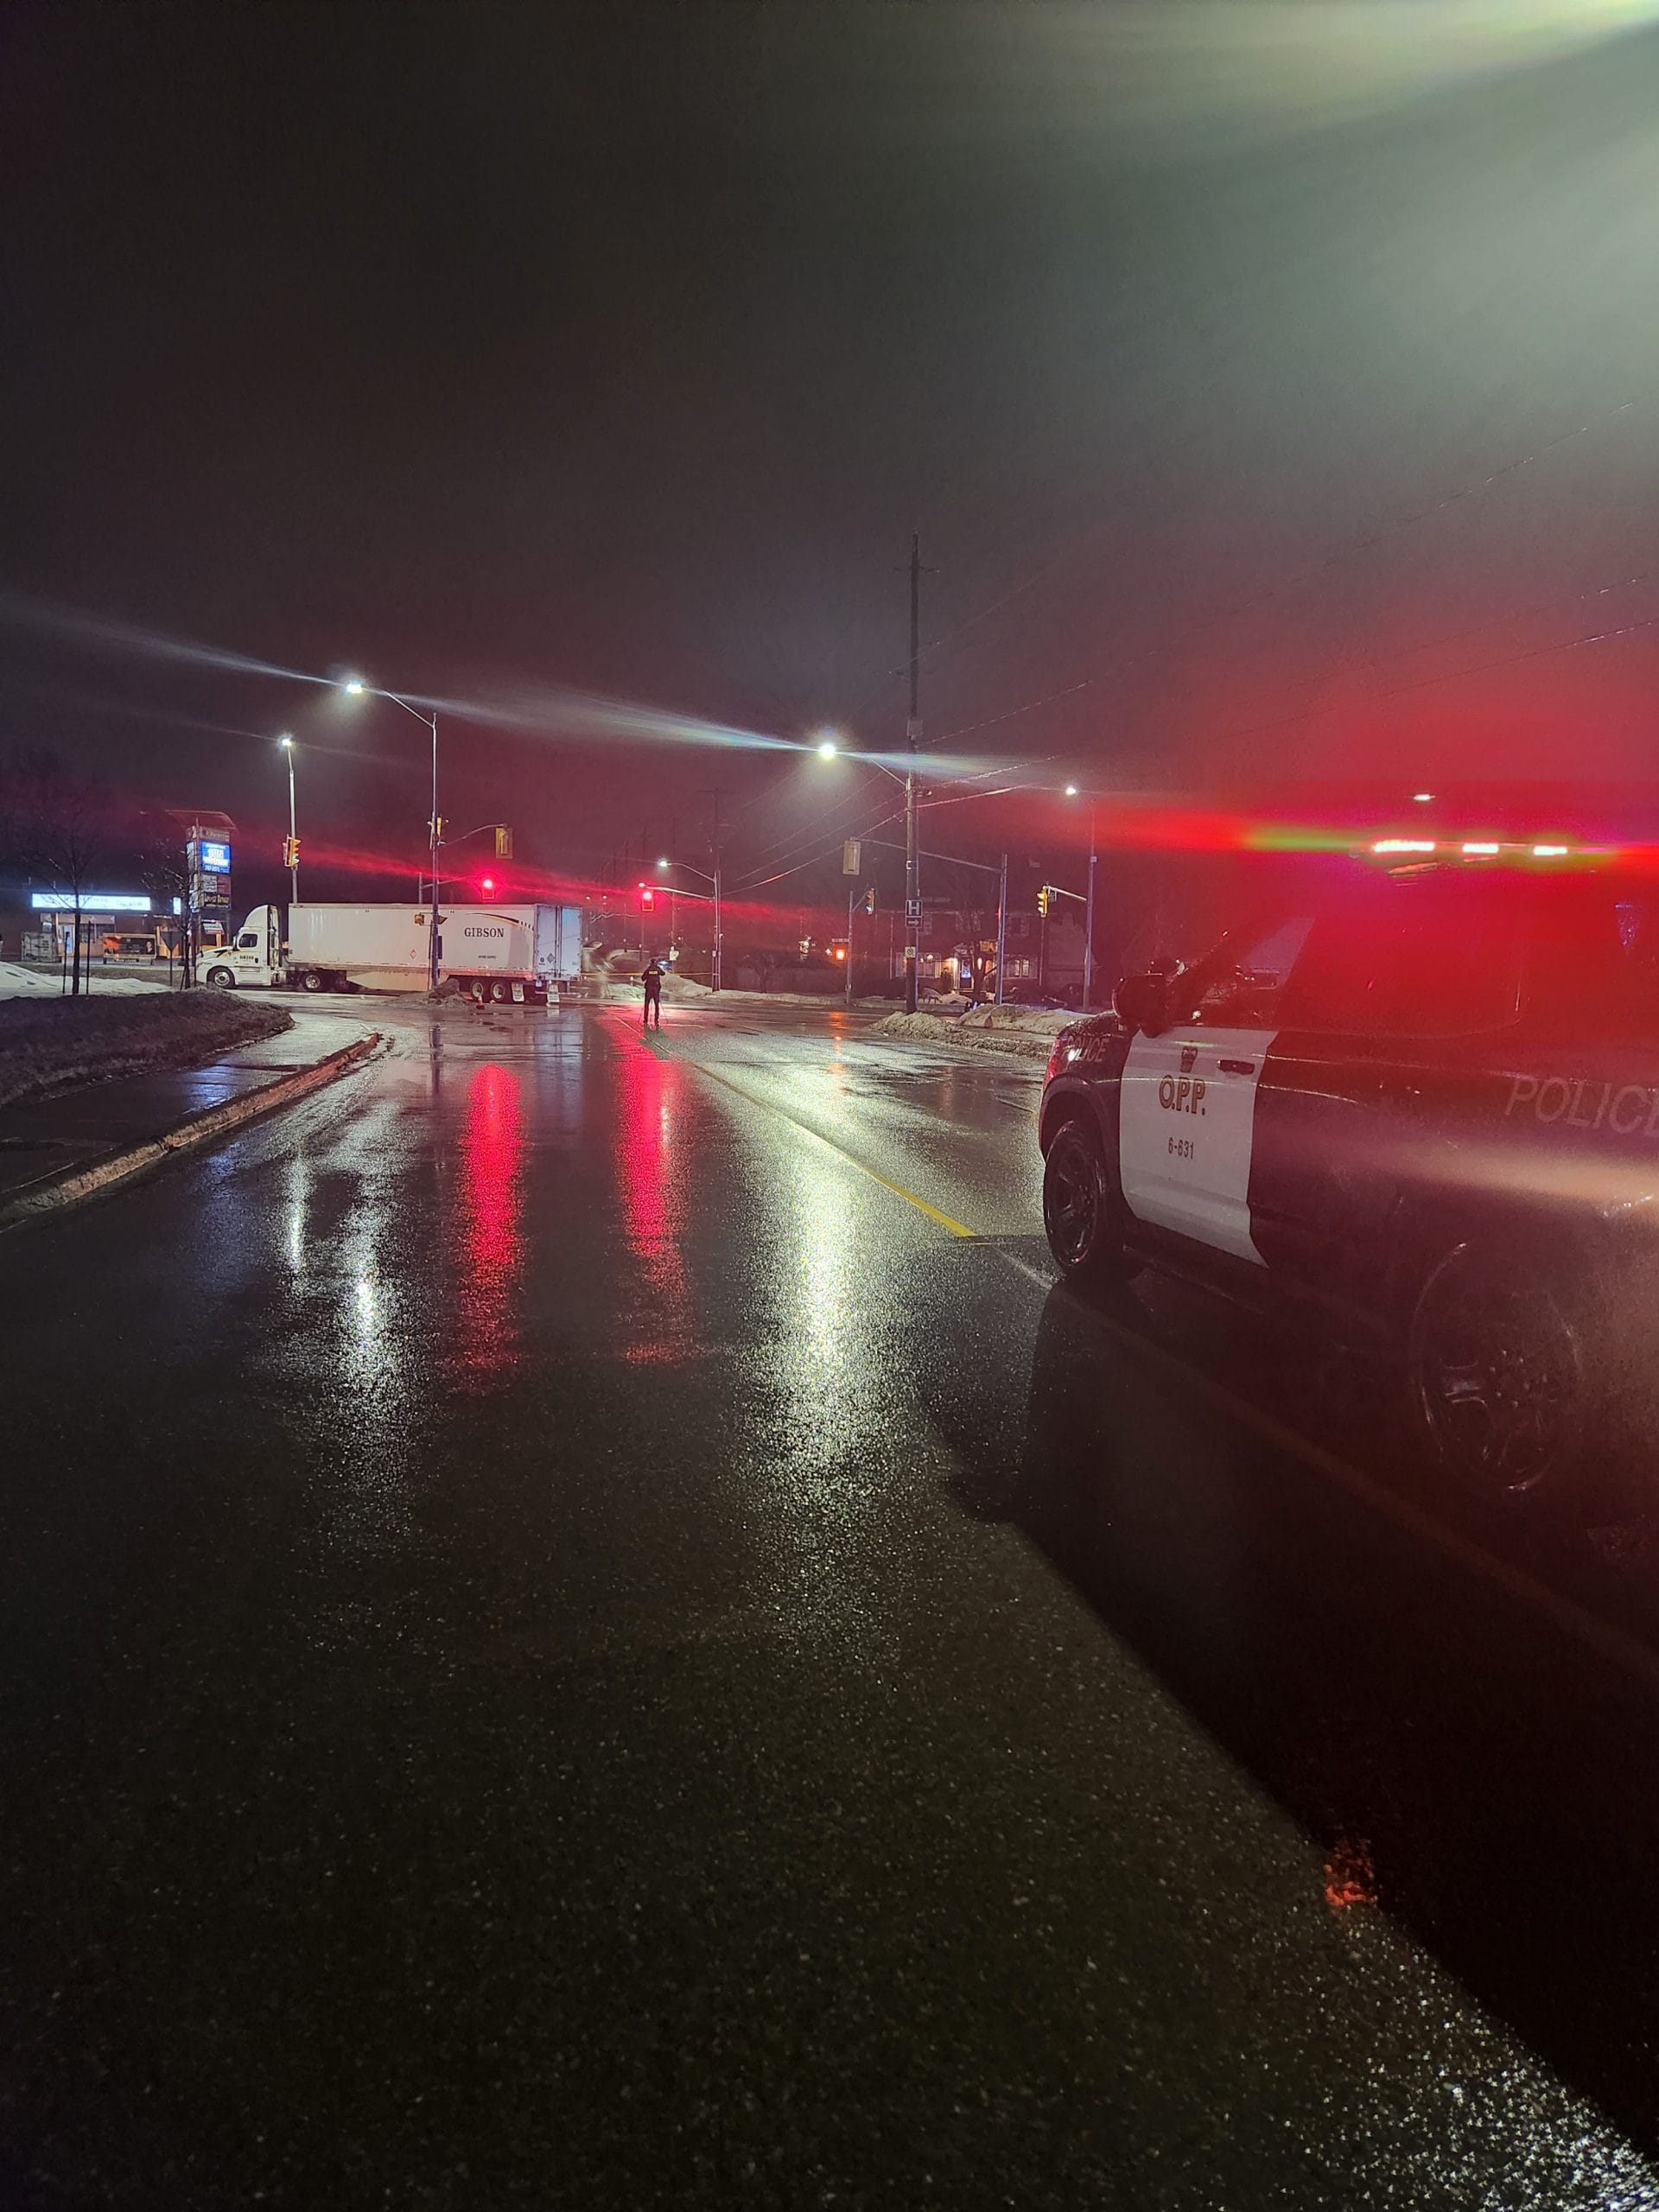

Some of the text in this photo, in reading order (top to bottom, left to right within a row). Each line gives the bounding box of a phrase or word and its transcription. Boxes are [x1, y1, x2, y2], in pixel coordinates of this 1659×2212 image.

[908, 899, 919, 915] H
[464, 927, 505, 938] GIBSON
[1159, 1074, 1206, 1116] O.P.P.
[1167, 1136, 1195, 1160] 6-631
